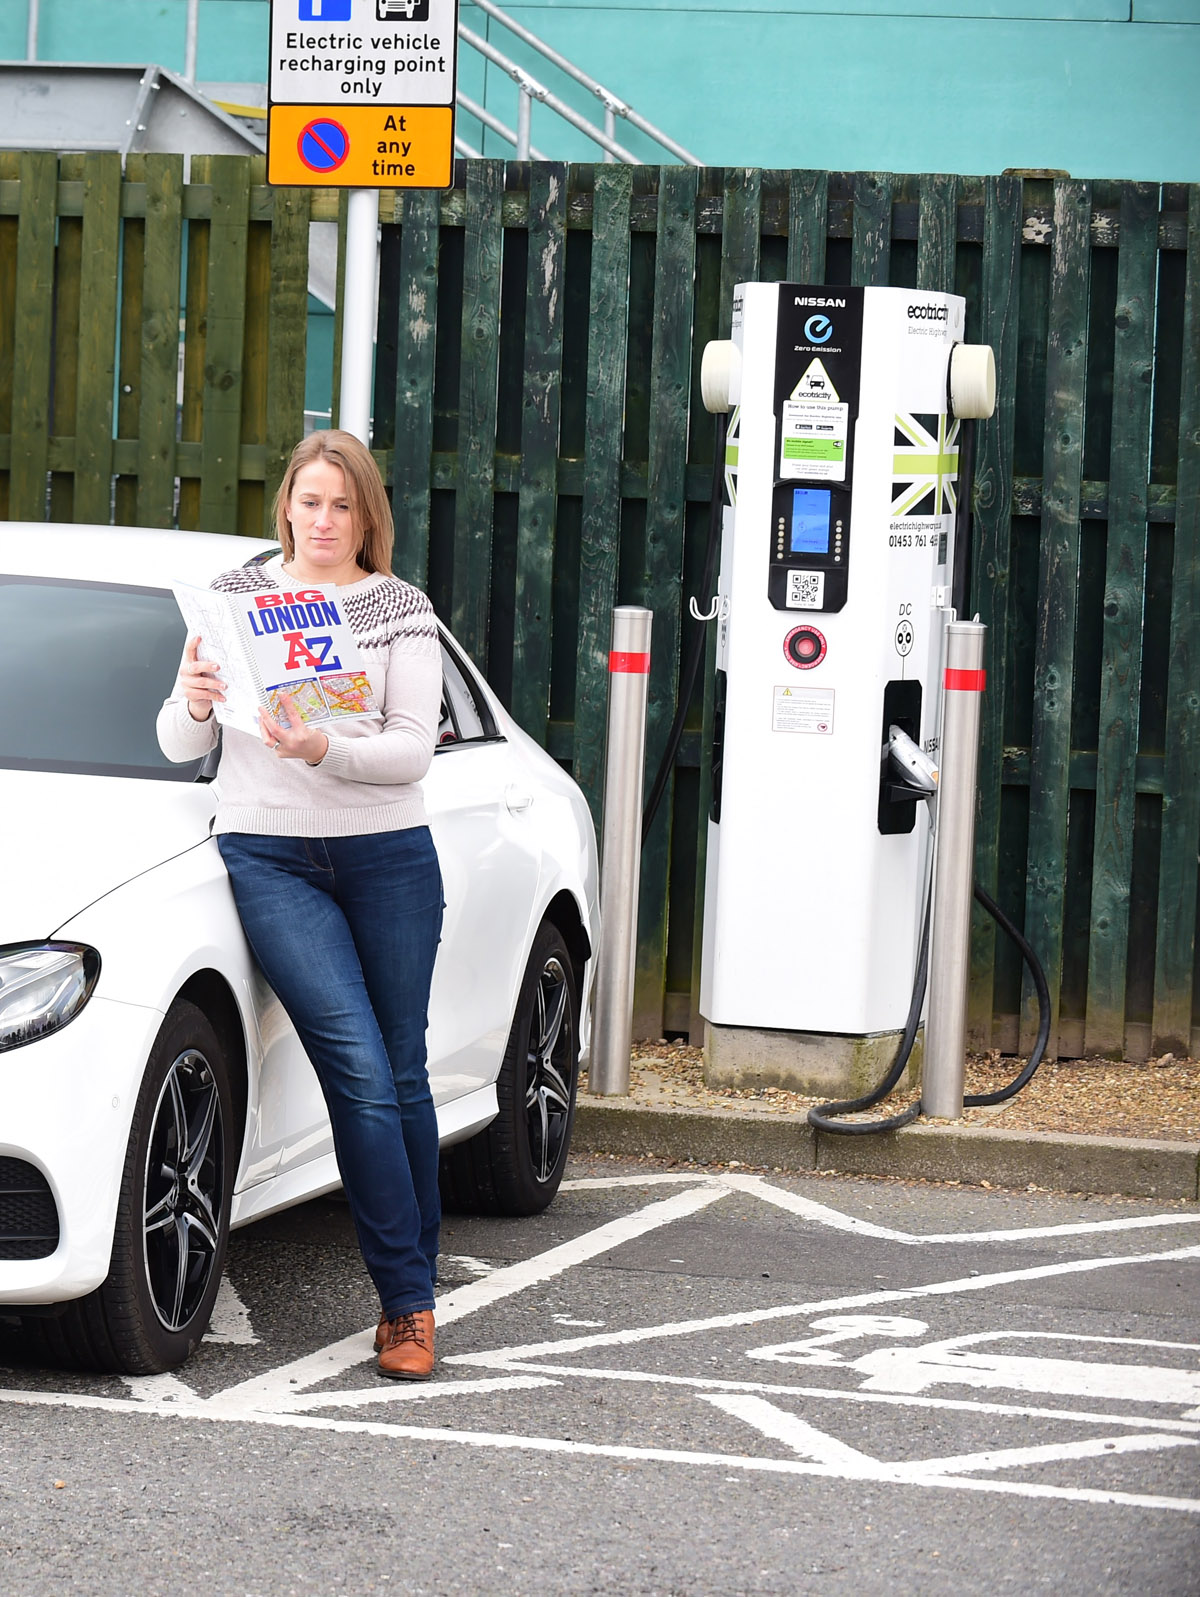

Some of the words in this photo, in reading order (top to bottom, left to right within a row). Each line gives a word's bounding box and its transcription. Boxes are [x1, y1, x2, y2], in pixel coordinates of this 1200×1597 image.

[286, 33, 363, 50] Electric
[371, 34, 441, 50] vehicle
[279, 56, 386, 75] recharging
[394, 57, 446, 75] point
[341, 78, 382, 97] only
[384, 115, 407, 132] At
[377, 141, 412, 156] any
[372, 160, 416, 176] time
[794, 296, 846, 308] NISSAN
[798, 391, 832, 400] ecotricity
[889, 535, 912, 547] 01453
[915, 535, 927, 547] 761
[254, 589, 326, 609] BIG
[899, 603, 912, 616] DC
[247, 600, 342, 637] LONDON
[924, 736, 940, 753] NISSA
